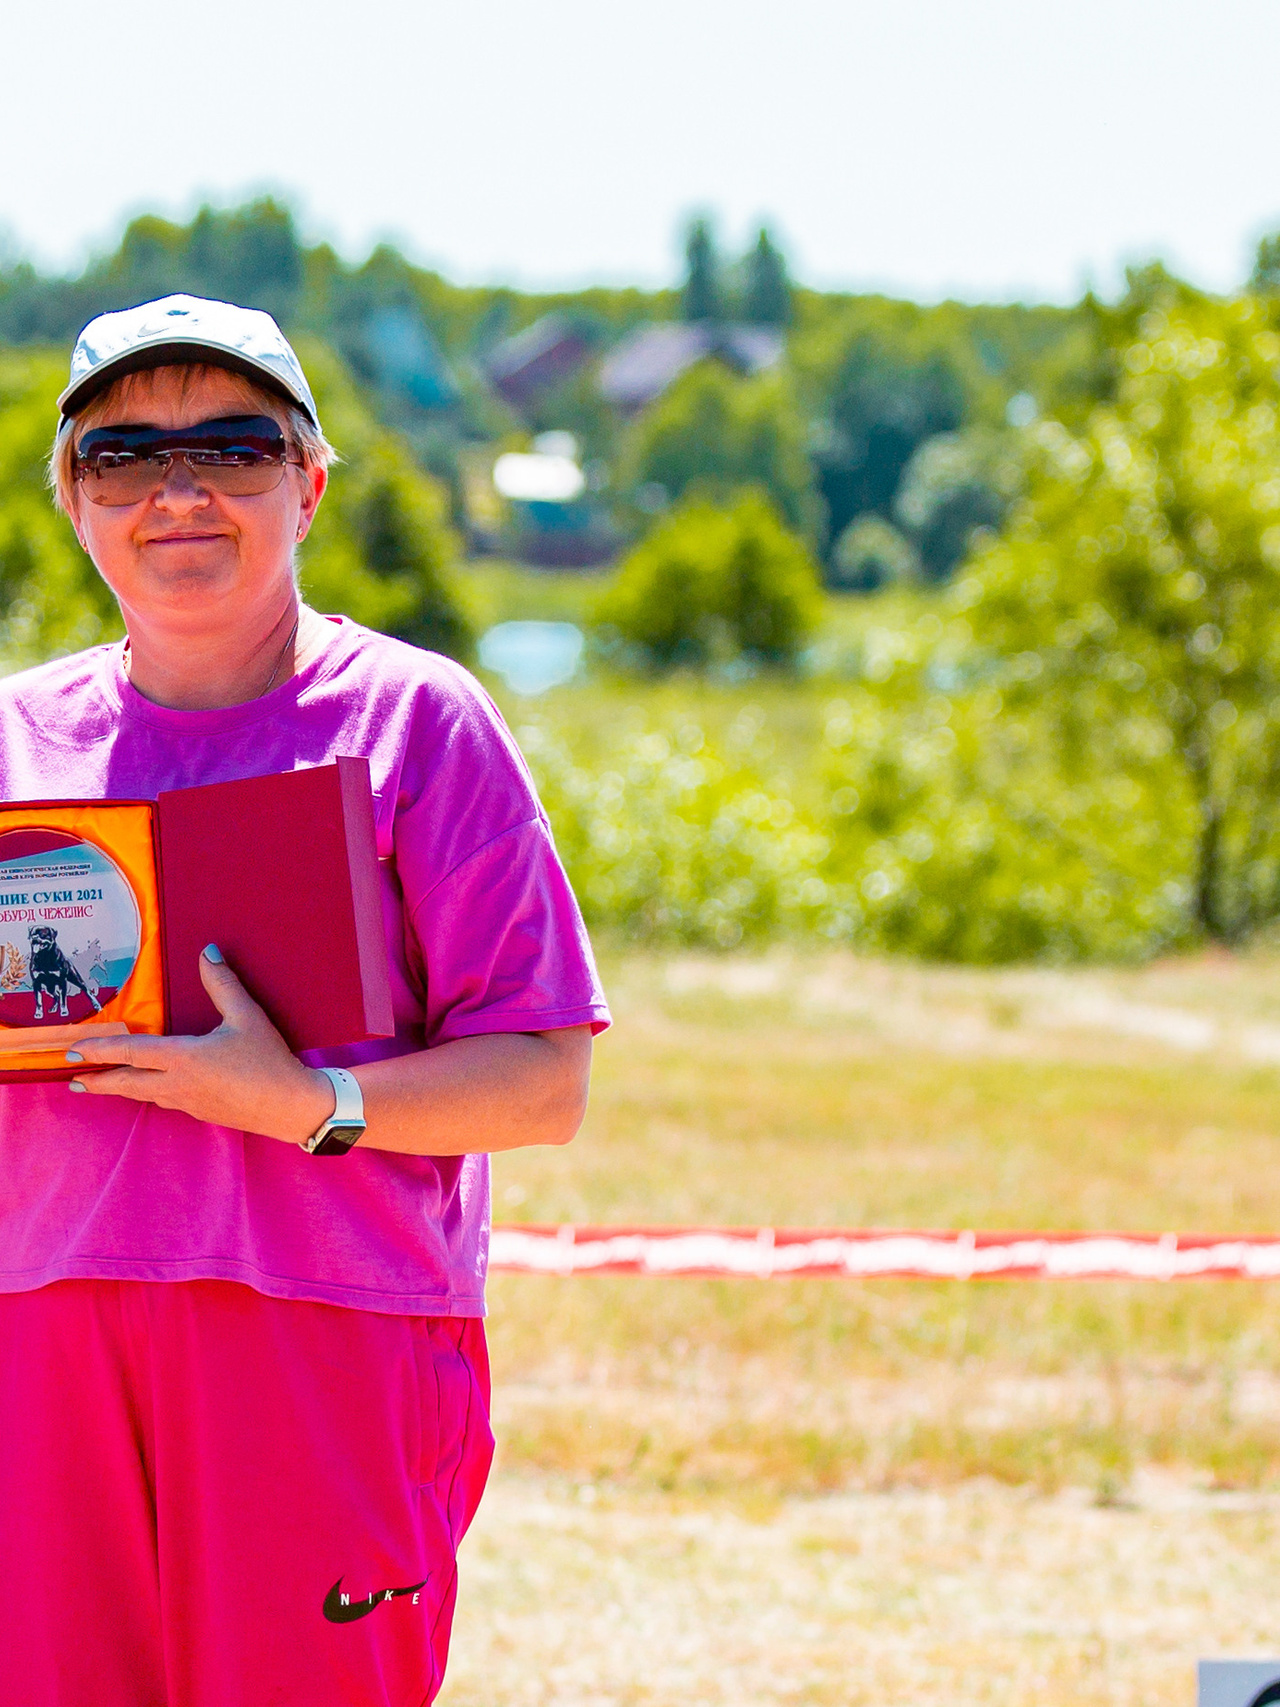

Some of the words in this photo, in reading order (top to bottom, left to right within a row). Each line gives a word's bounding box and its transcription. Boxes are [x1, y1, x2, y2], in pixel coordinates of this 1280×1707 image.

[33, 890, 72, 904] СУКИ
[77, 889, 103, 901] 2021
[39, 904, 93, 919] ЧЕЖЕЛИС
[340, 1589, 420, 1606] NIKE
